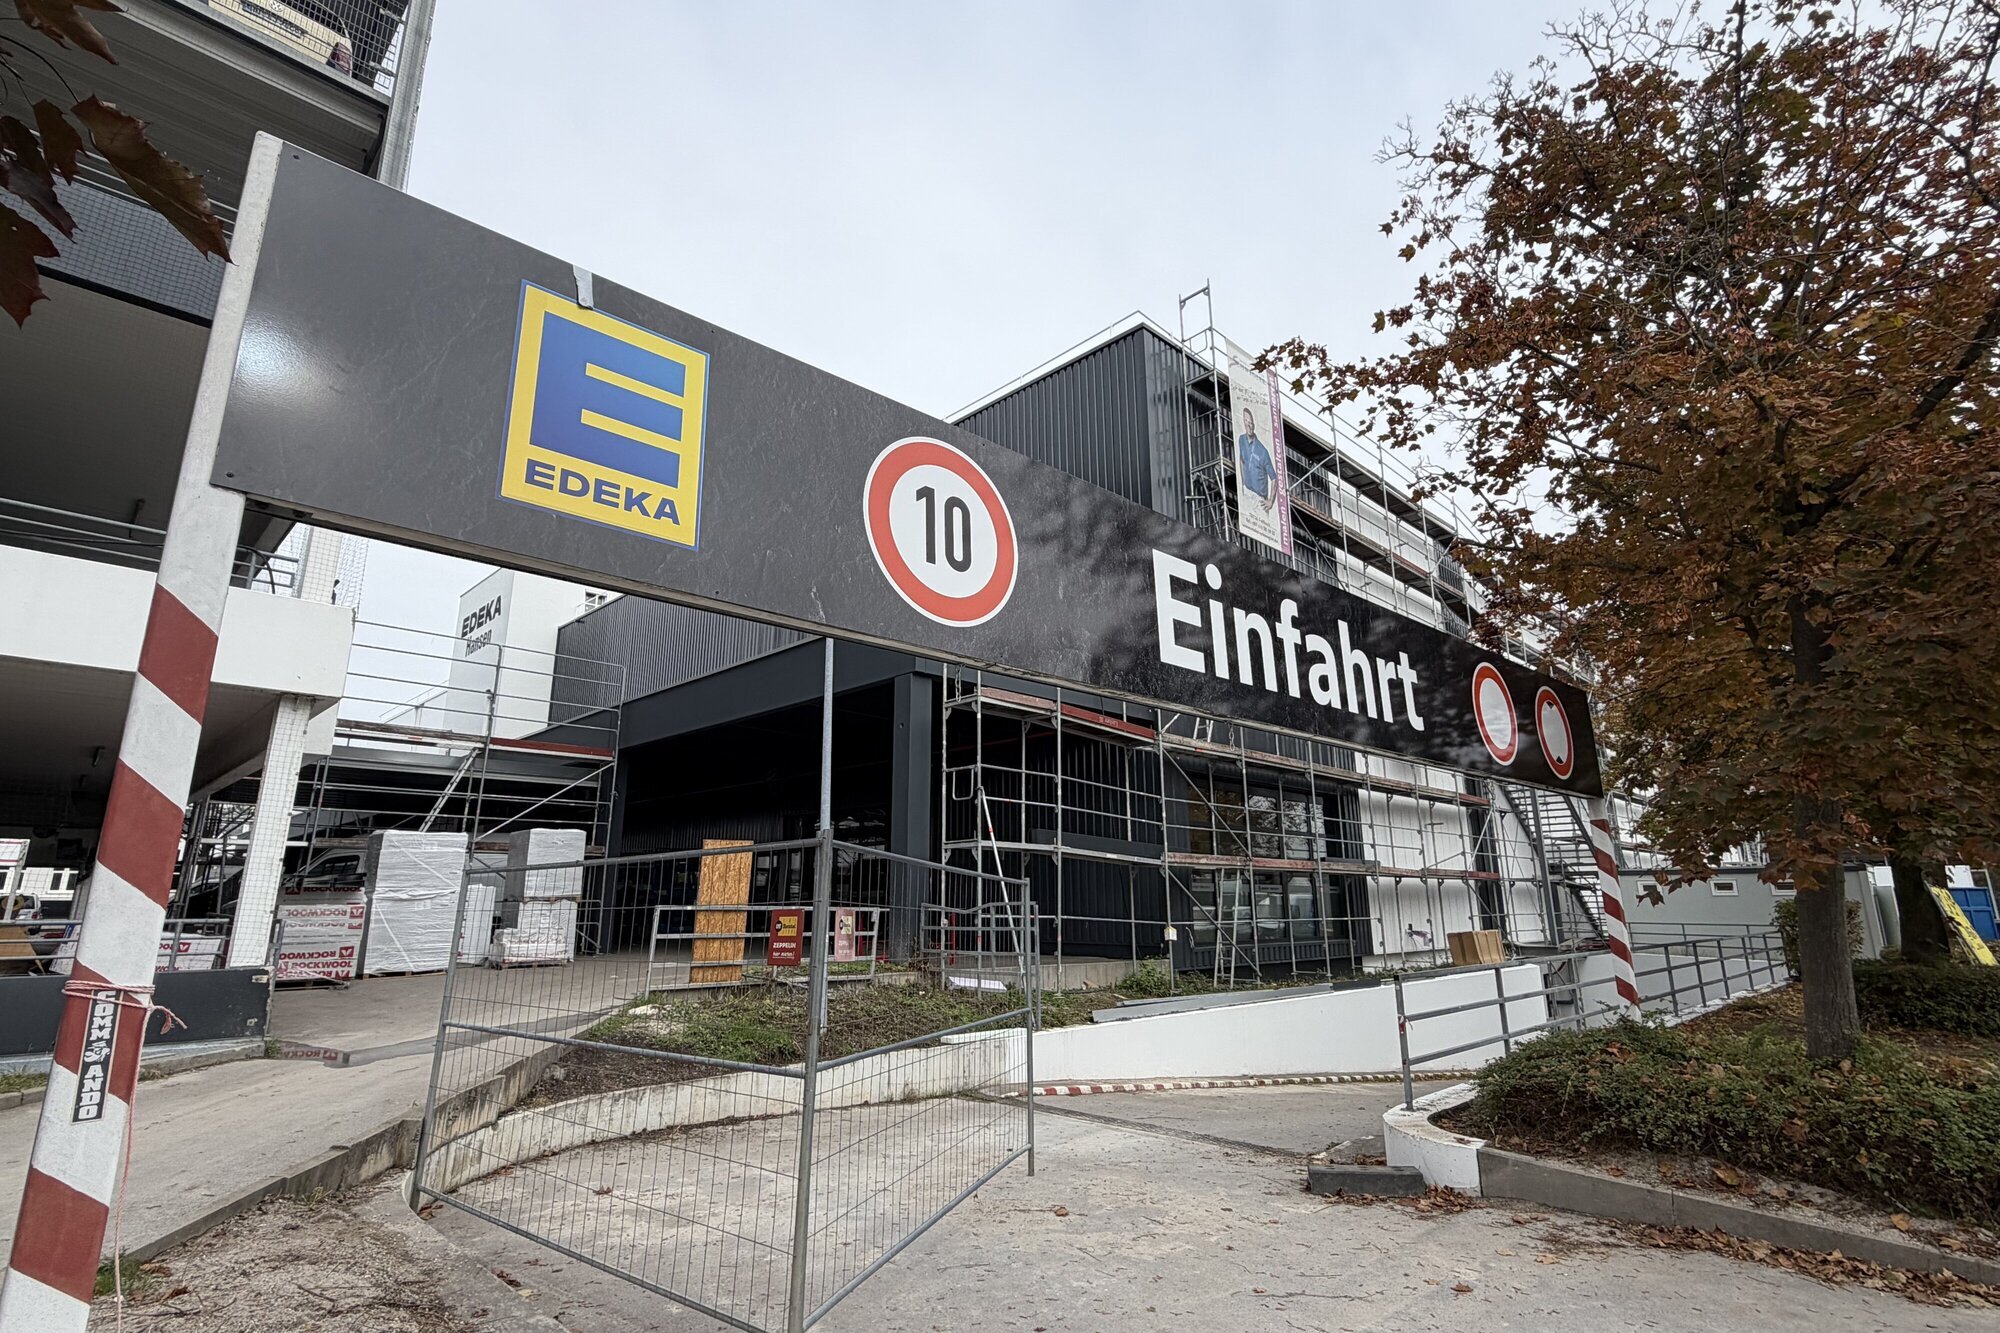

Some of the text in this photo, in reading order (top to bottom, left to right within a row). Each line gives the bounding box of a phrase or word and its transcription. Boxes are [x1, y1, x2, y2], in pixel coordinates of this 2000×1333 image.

[1275, 438, 1287, 496] gestalten
[524, 458, 681, 526] EDEKA
[916, 485, 972, 573] 10
[1280, 506, 1289, 546] malen
[461, 594, 502, 638] EDEKA
[1152, 548, 1425, 732] Einfahrt
[286, 909, 347, 917] ROCKWOOL
[279, 950, 337, 960] ROCKWOO
[291, 961, 353, 969] ROCKWOOL
